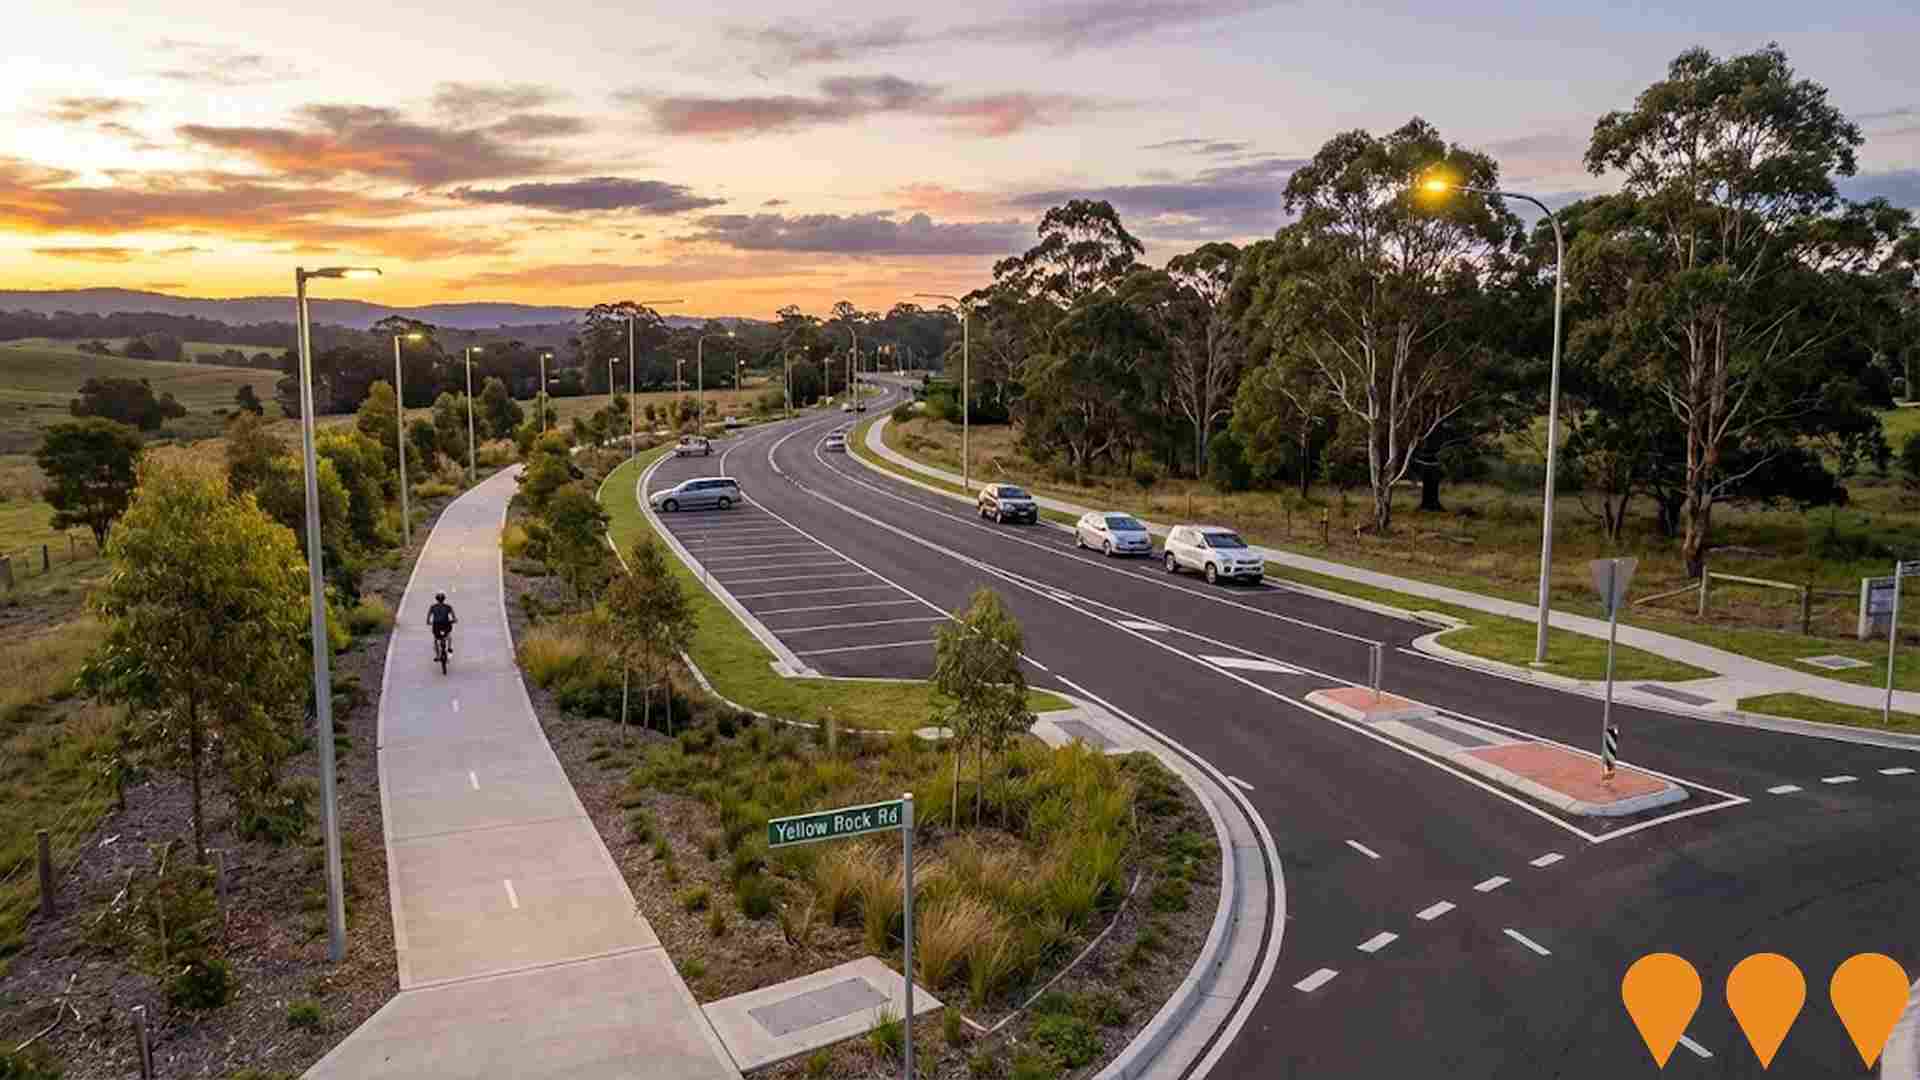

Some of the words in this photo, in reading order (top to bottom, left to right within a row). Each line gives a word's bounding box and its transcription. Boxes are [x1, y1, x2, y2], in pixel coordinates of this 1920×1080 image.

[776, 821, 827, 842] Yellow
[834, 813, 871, 832] Rock
[878, 808, 897, 824] Rd
